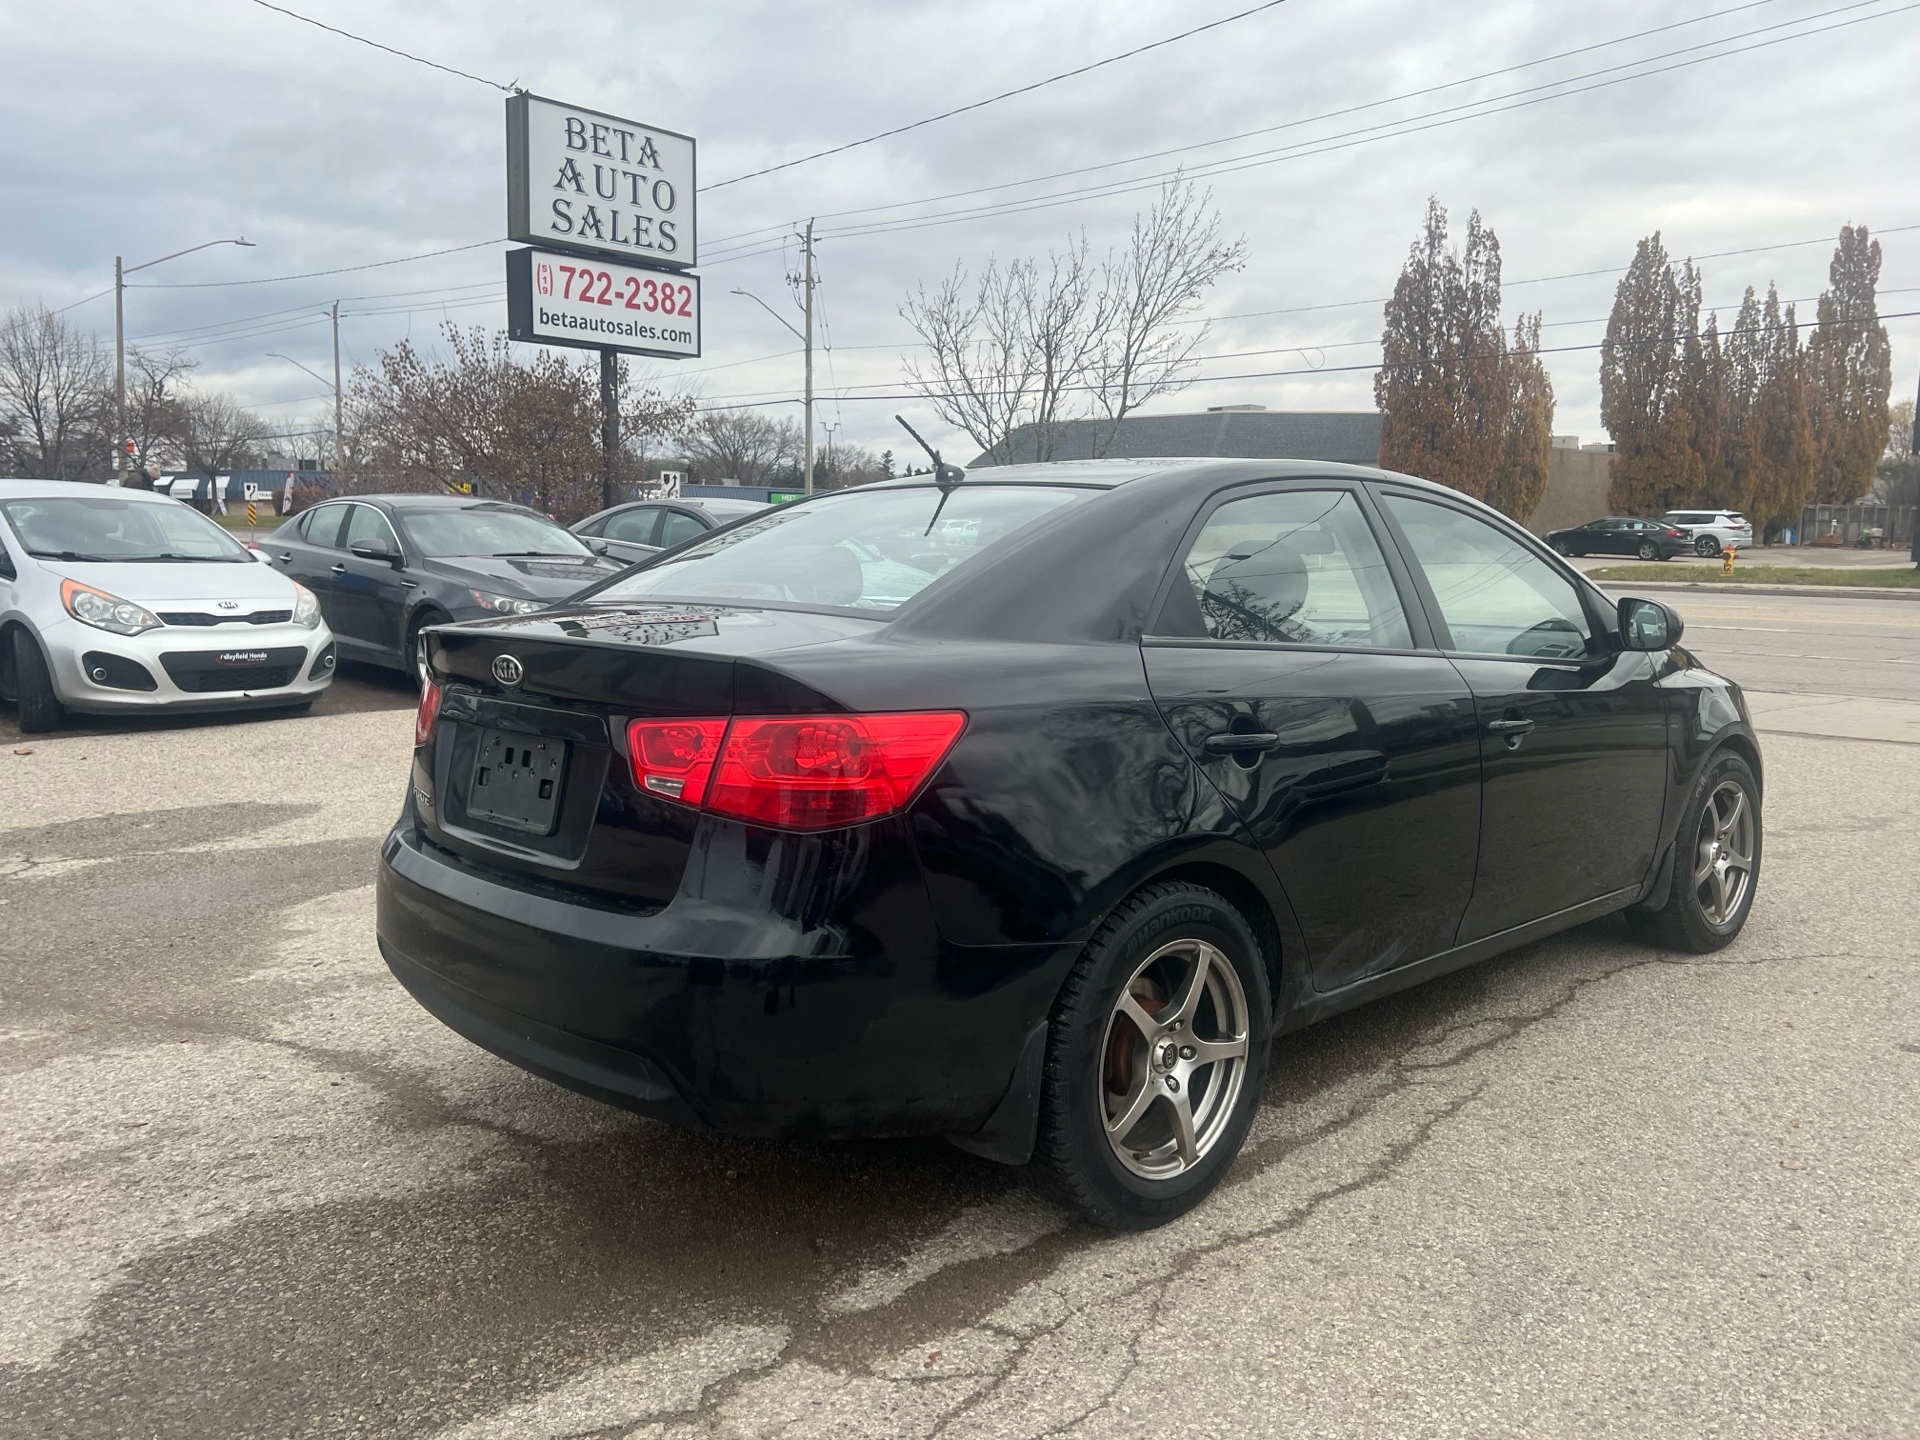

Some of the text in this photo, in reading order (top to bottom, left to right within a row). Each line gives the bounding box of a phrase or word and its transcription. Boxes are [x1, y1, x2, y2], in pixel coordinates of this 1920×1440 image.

[564, 116, 663, 171] BETA
[554, 157, 677, 213] AUTO
[551, 198, 678, 254] SALES
[559, 265, 692, 318] 722-2382
[539, 307, 692, 344] betaautosales.com
[495, 657, 518, 680] KIA
